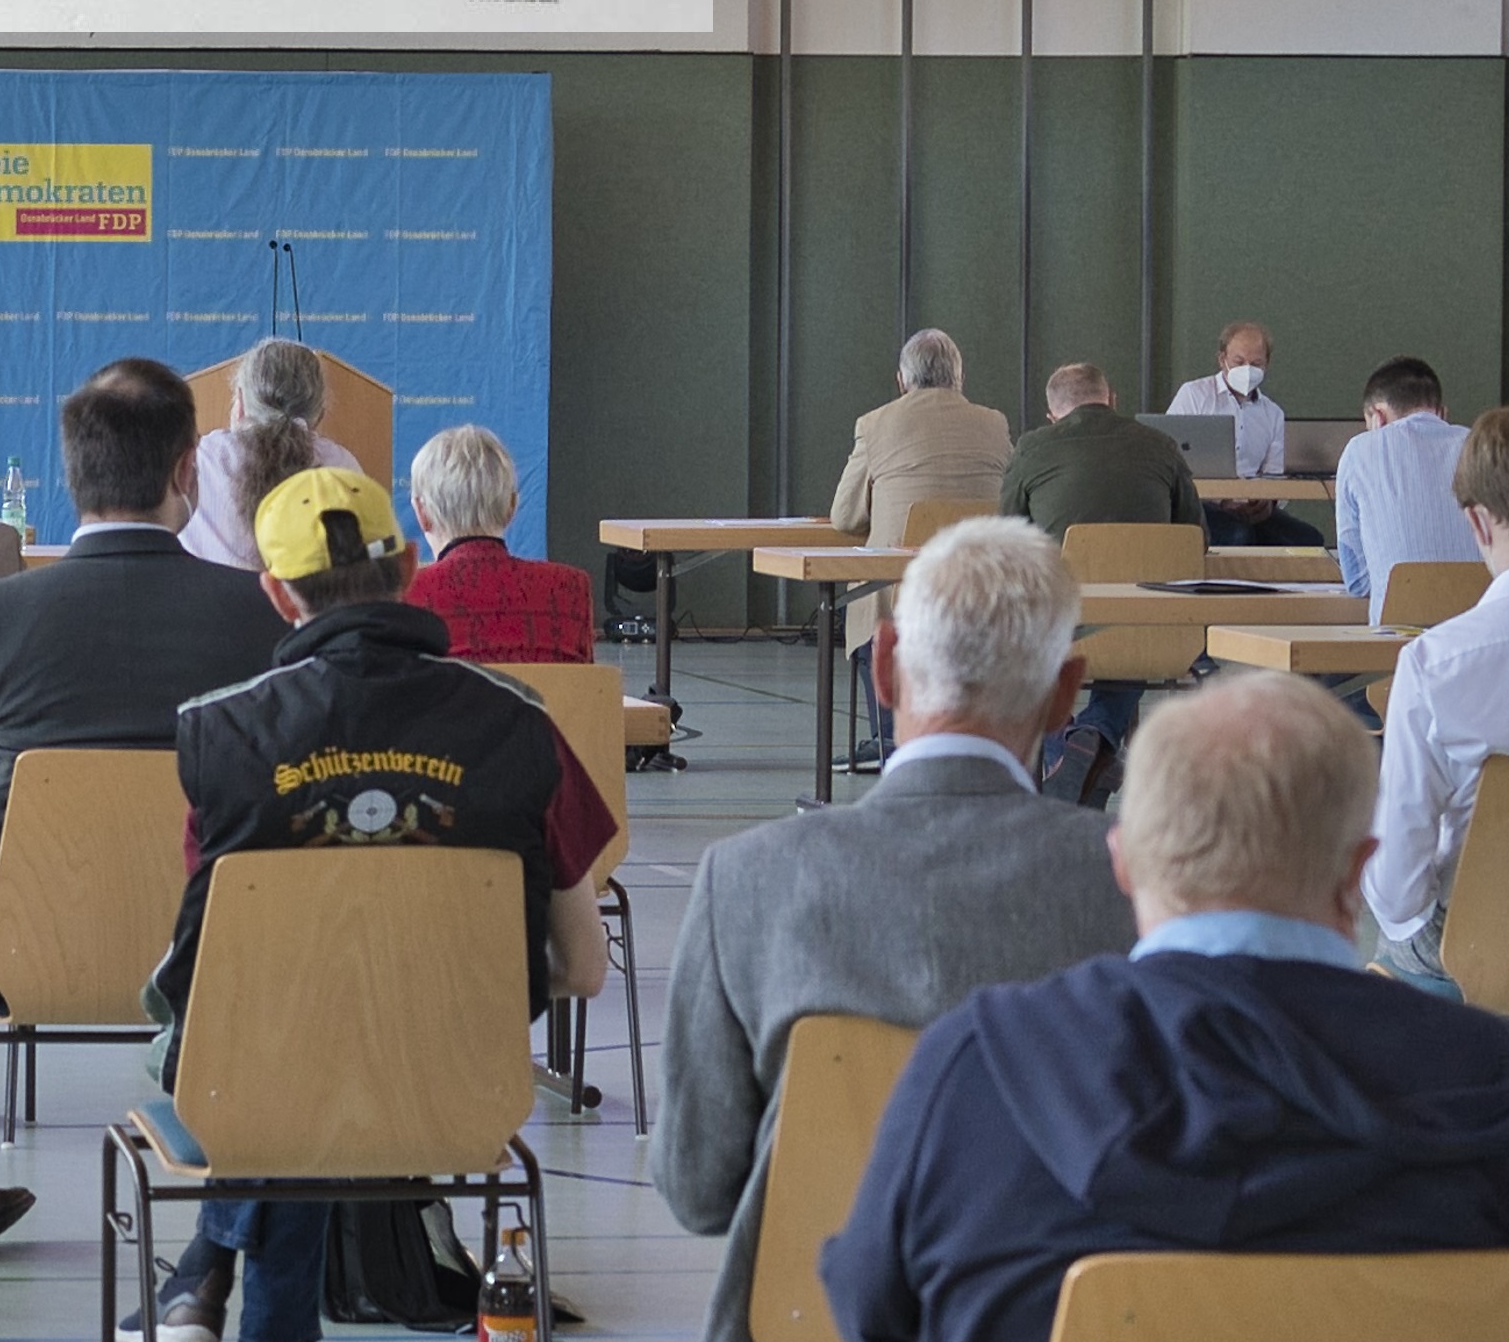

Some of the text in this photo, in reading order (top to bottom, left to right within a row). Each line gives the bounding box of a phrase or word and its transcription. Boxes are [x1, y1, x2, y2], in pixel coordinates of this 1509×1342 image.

[20, 213, 141, 230] Osnabrücker Land FDP
[273, 747, 465, 795] Schützenverein
